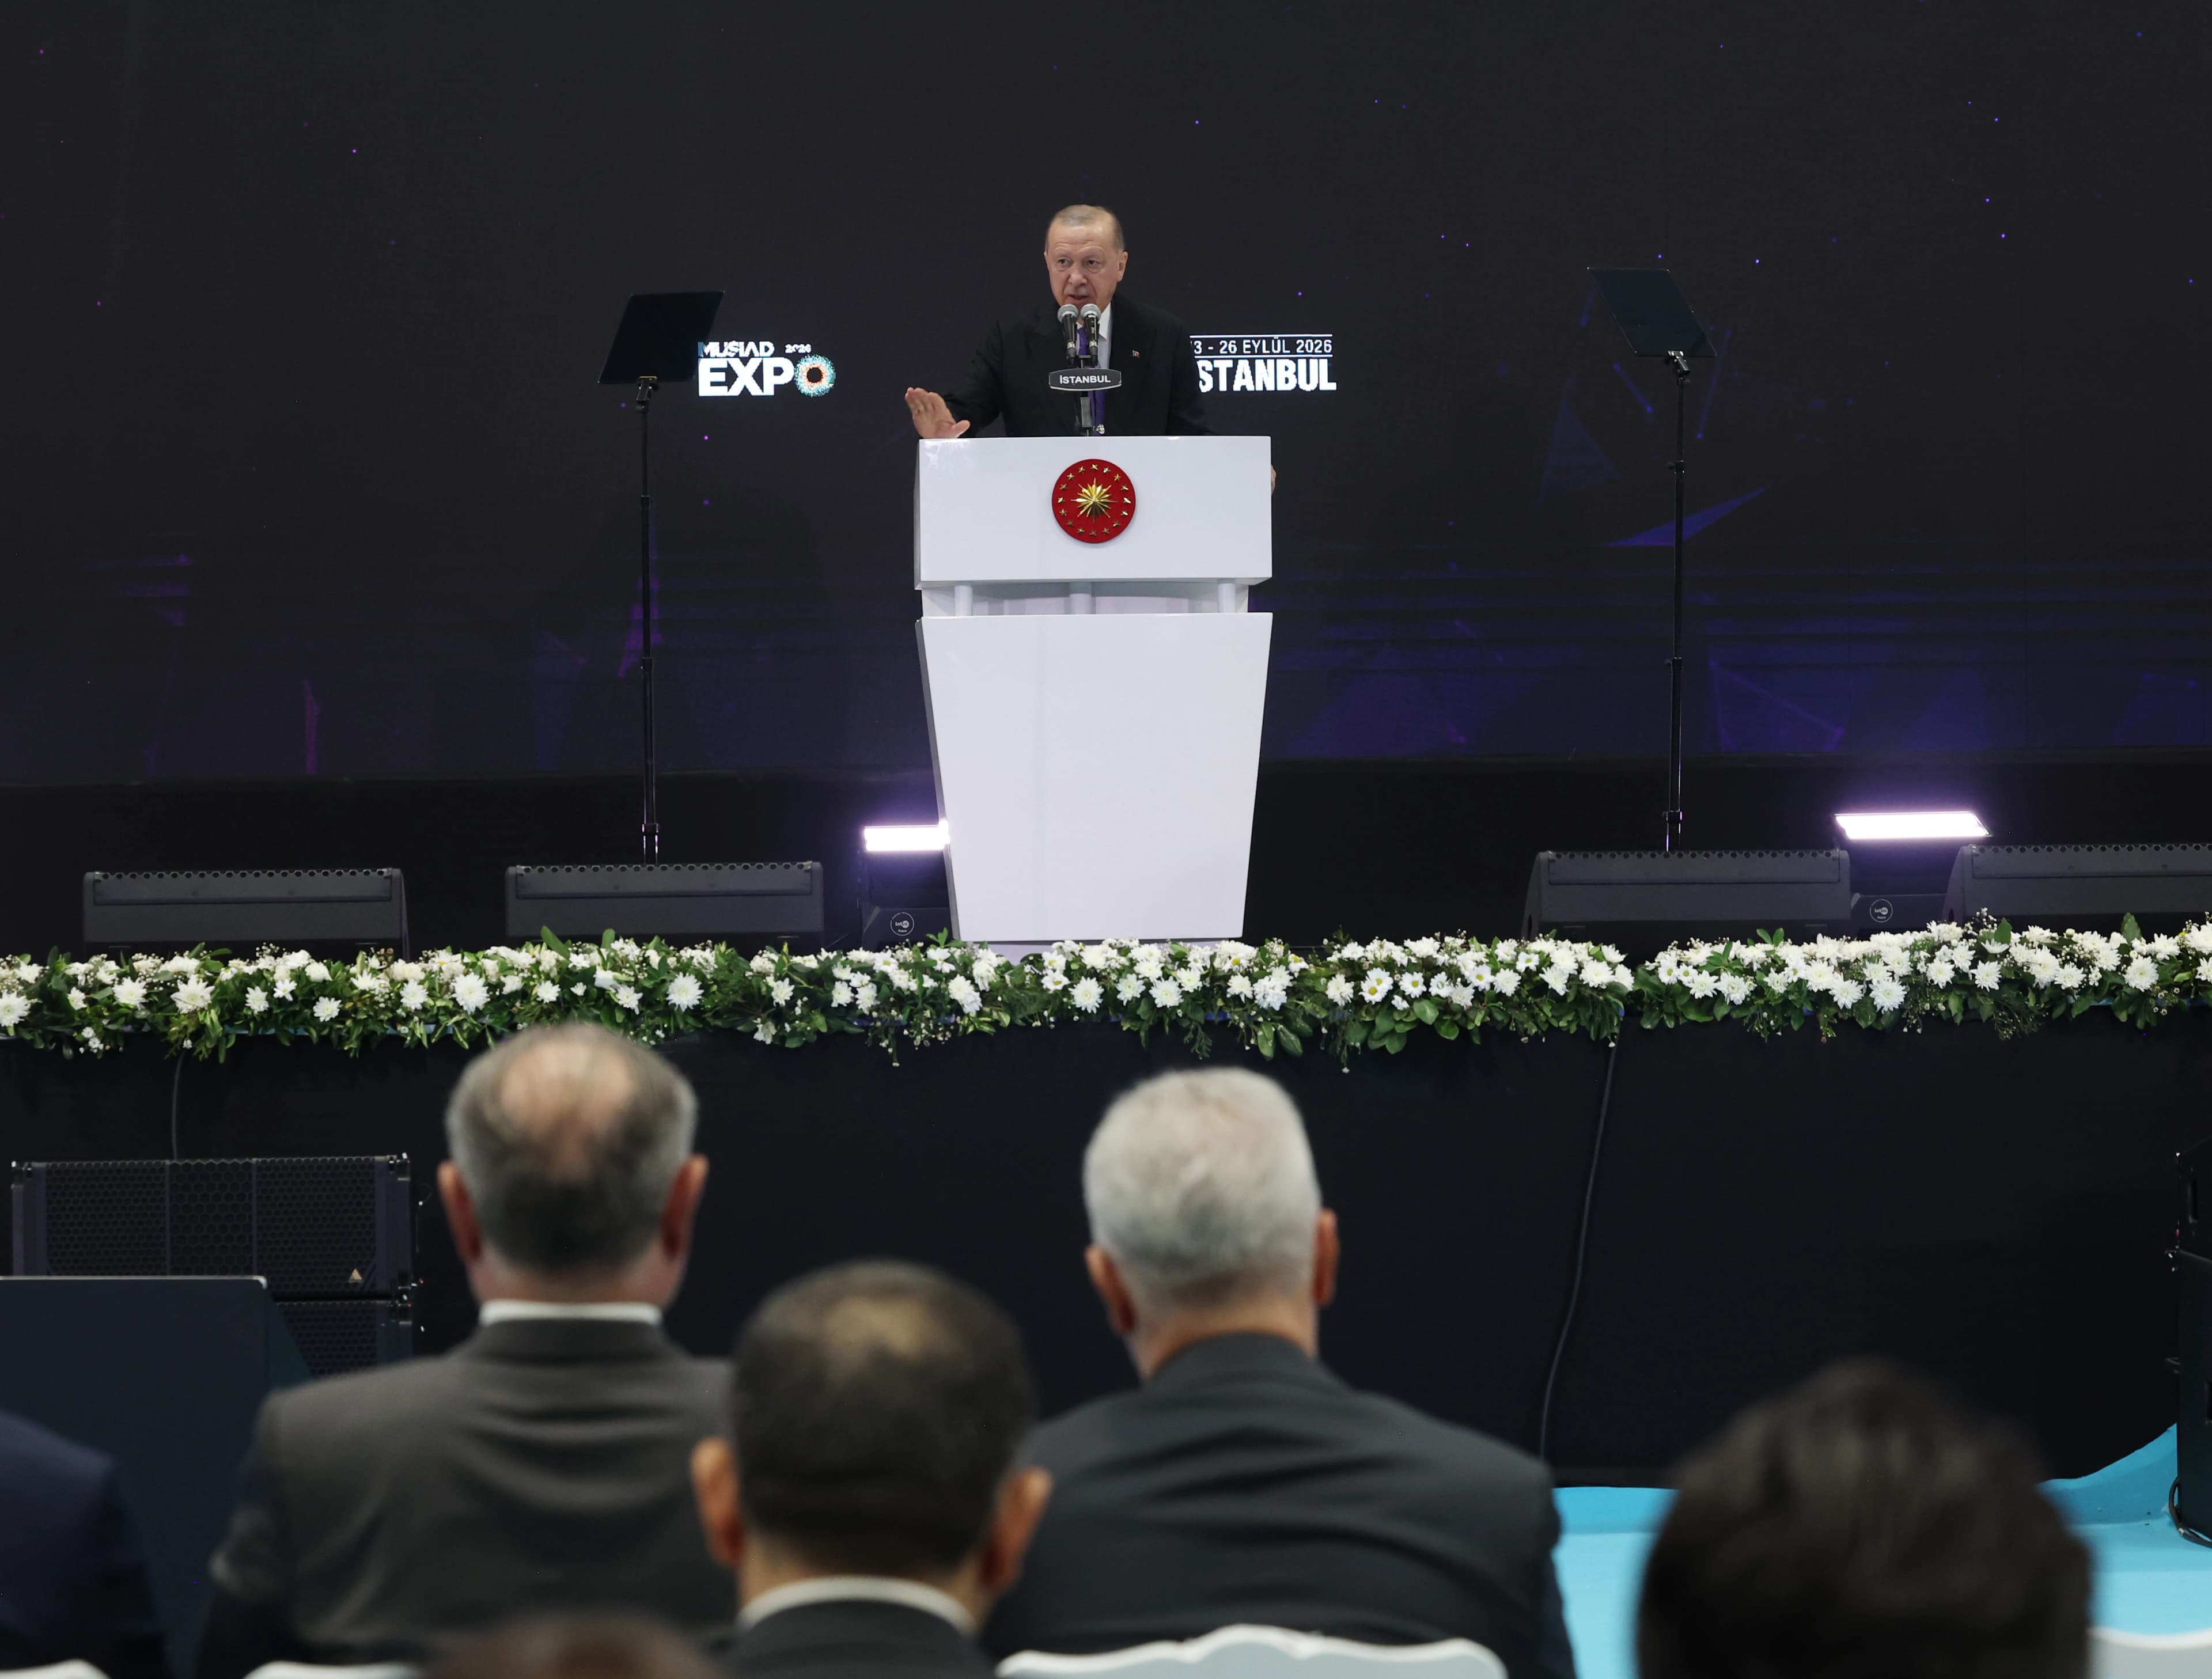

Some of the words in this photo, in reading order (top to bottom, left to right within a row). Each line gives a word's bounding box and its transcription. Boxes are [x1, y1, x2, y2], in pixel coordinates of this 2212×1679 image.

[1190, 340, 1202, 354] 3
[1219, 340, 1237, 354] 26
[1243, 336, 1291, 354] EYLÜL
[1296, 339, 1333, 354] 2026
[698, 354, 836, 397] EXPO
[1059, 375, 1111, 384] İSTANBUL
[1196, 358, 1337, 393] STANBUL
